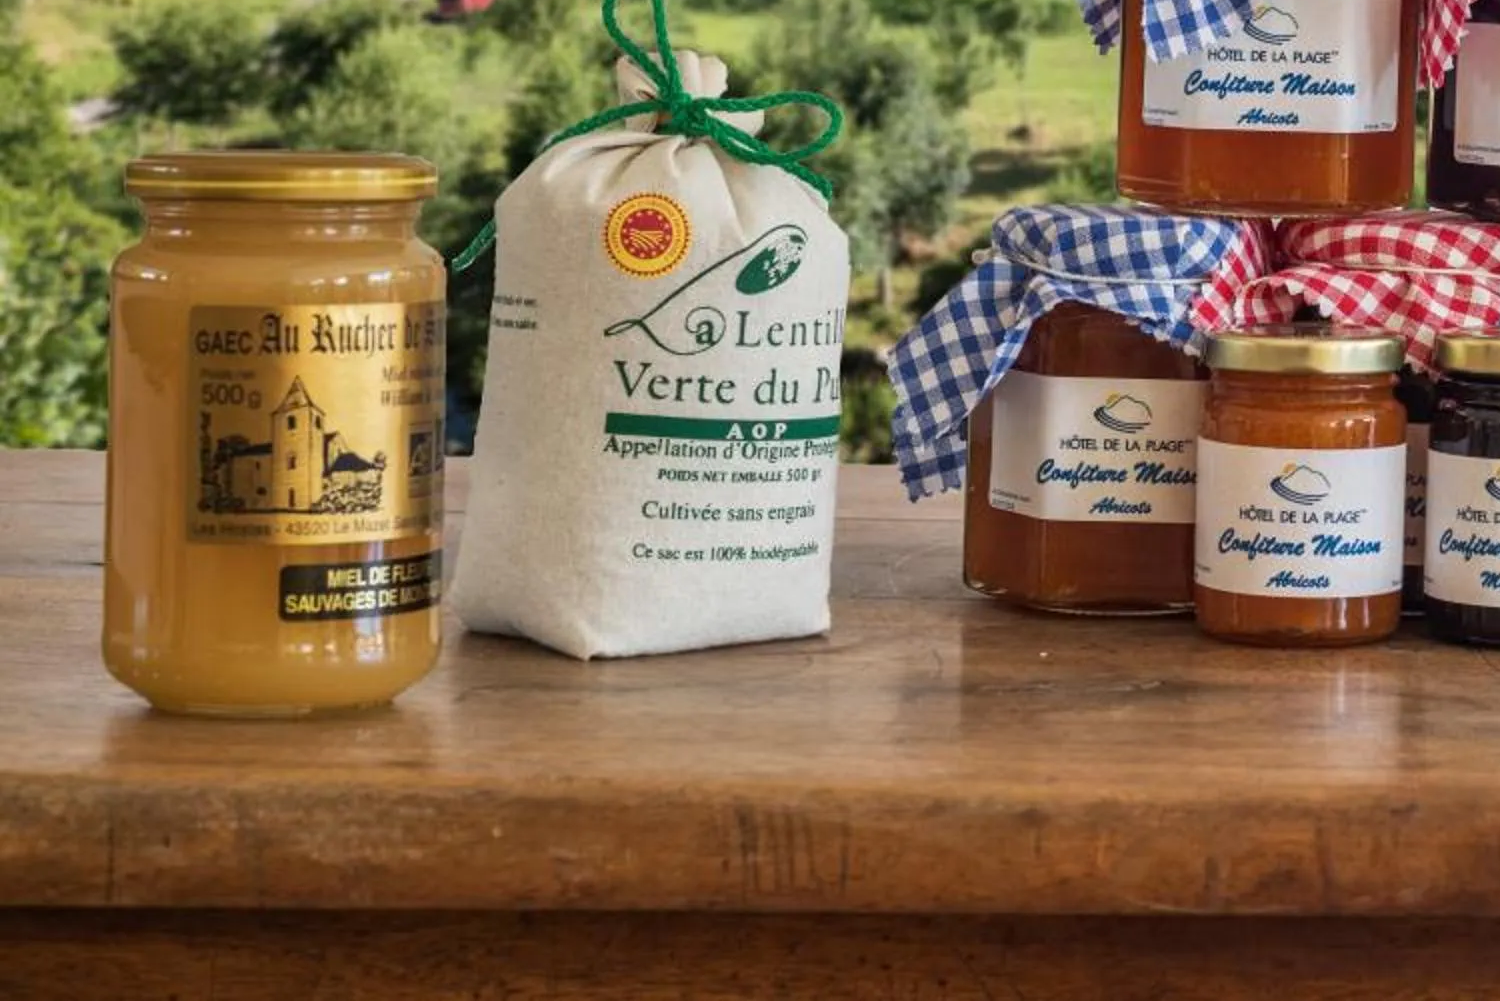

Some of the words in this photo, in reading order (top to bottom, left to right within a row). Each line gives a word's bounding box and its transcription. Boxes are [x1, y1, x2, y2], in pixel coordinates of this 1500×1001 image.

[1251, 49, 1267, 62] DE
[1272, 50, 1288, 62] LA
[1184, 70, 1275, 99] Confiture
[1280, 72, 1356, 97] Maison
[1237, 107, 1300, 126] Abricots
[195, 329, 253, 355] GAEC
[259, 312, 299, 355] Au
[310, 313, 397, 359] Rucher
[614, 360, 736, 405] Verte
[753, 368, 799, 405] du
[202, 383, 245, 406] 500
[248, 389, 262, 411] g
[603, 435, 717, 461] Appellation
[723, 439, 800, 463] d'Origine
[1103, 438, 1121, 451] DE
[1125, 438, 1141, 452] LA
[657, 468, 699, 482] POIDS
[702, 470, 726, 483] NET
[787, 468, 808, 481] 500
[1036, 458, 1128, 489] Confiture
[1133, 461, 1197, 485] Mais
[641, 501, 721, 522] Cultivée
[727, 506, 763, 522] sans
[768, 500, 816, 524] engrais
[1088, 496, 1152, 515] Abricots
[1280, 510, 1297, 524] DE
[1302, 511, 1319, 524] LA
[633, 543, 654, 559] Ce
[658, 548, 681, 561] sac
[685, 547, 704, 560] est
[710, 546, 746, 562] 100%
[1218, 527, 1305, 561] Confiture
[1311, 534, 1381, 557] Maison
[327, 568, 367, 588] MIEL
[369, 565, 391, 586] DE
[1265, 570, 1330, 588] Abricots
[285, 590, 377, 615] SAUVAGES
[379, 588, 398, 608] DE
